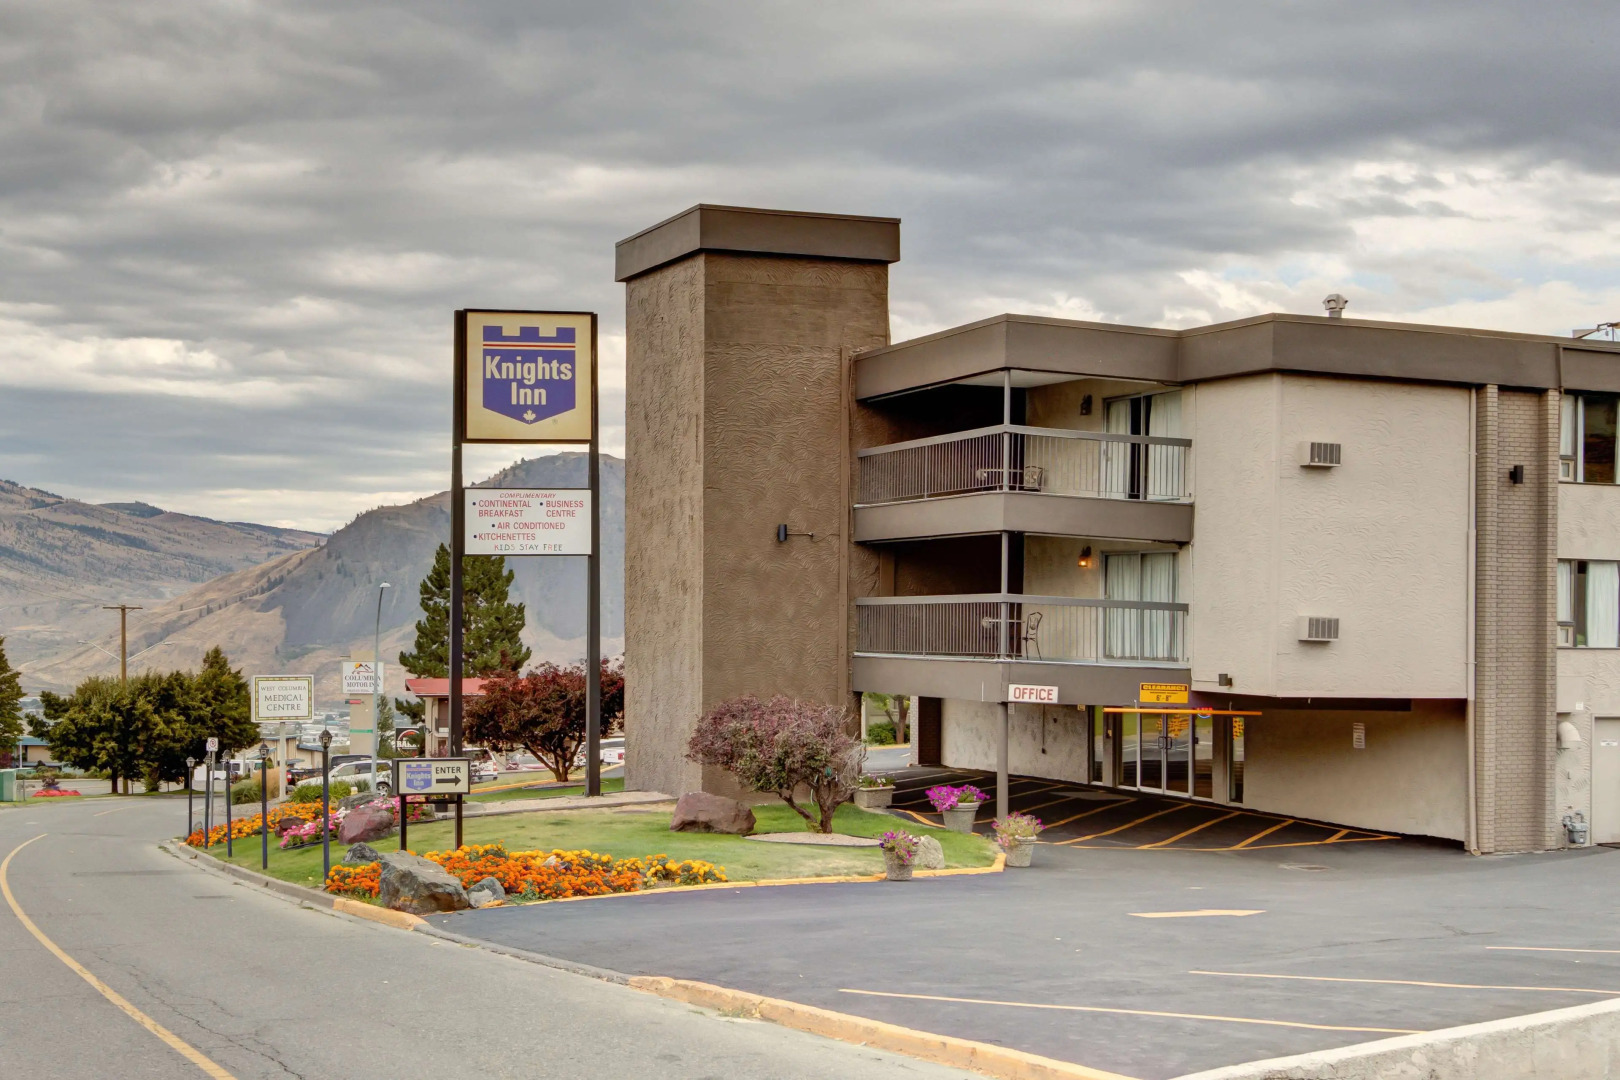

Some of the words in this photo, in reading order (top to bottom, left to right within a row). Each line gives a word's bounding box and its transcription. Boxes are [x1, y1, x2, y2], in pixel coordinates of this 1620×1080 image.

[485, 355, 573, 385] Knights
[511, 382, 547, 405] Inn
[478, 500, 532, 508] CONTINENTAL
[545, 500, 584, 508] BUSINESS
[497, 522, 510, 530] AIR
[513, 522, 566, 530] CONDITIONED
[478, 533, 536, 541] KITCHENETTES
[494, 544, 515, 552] KIDS
[519, 544, 539, 552] STAY
[543, 544, 563, 552] FREE
[264, 694, 304, 702] MEDICAL
[1013, 687, 1054, 701] OFFICE
[266, 703, 301, 711] CENTRE
[435, 766, 462, 774] ENTER
[406, 772, 431, 780] Knights
